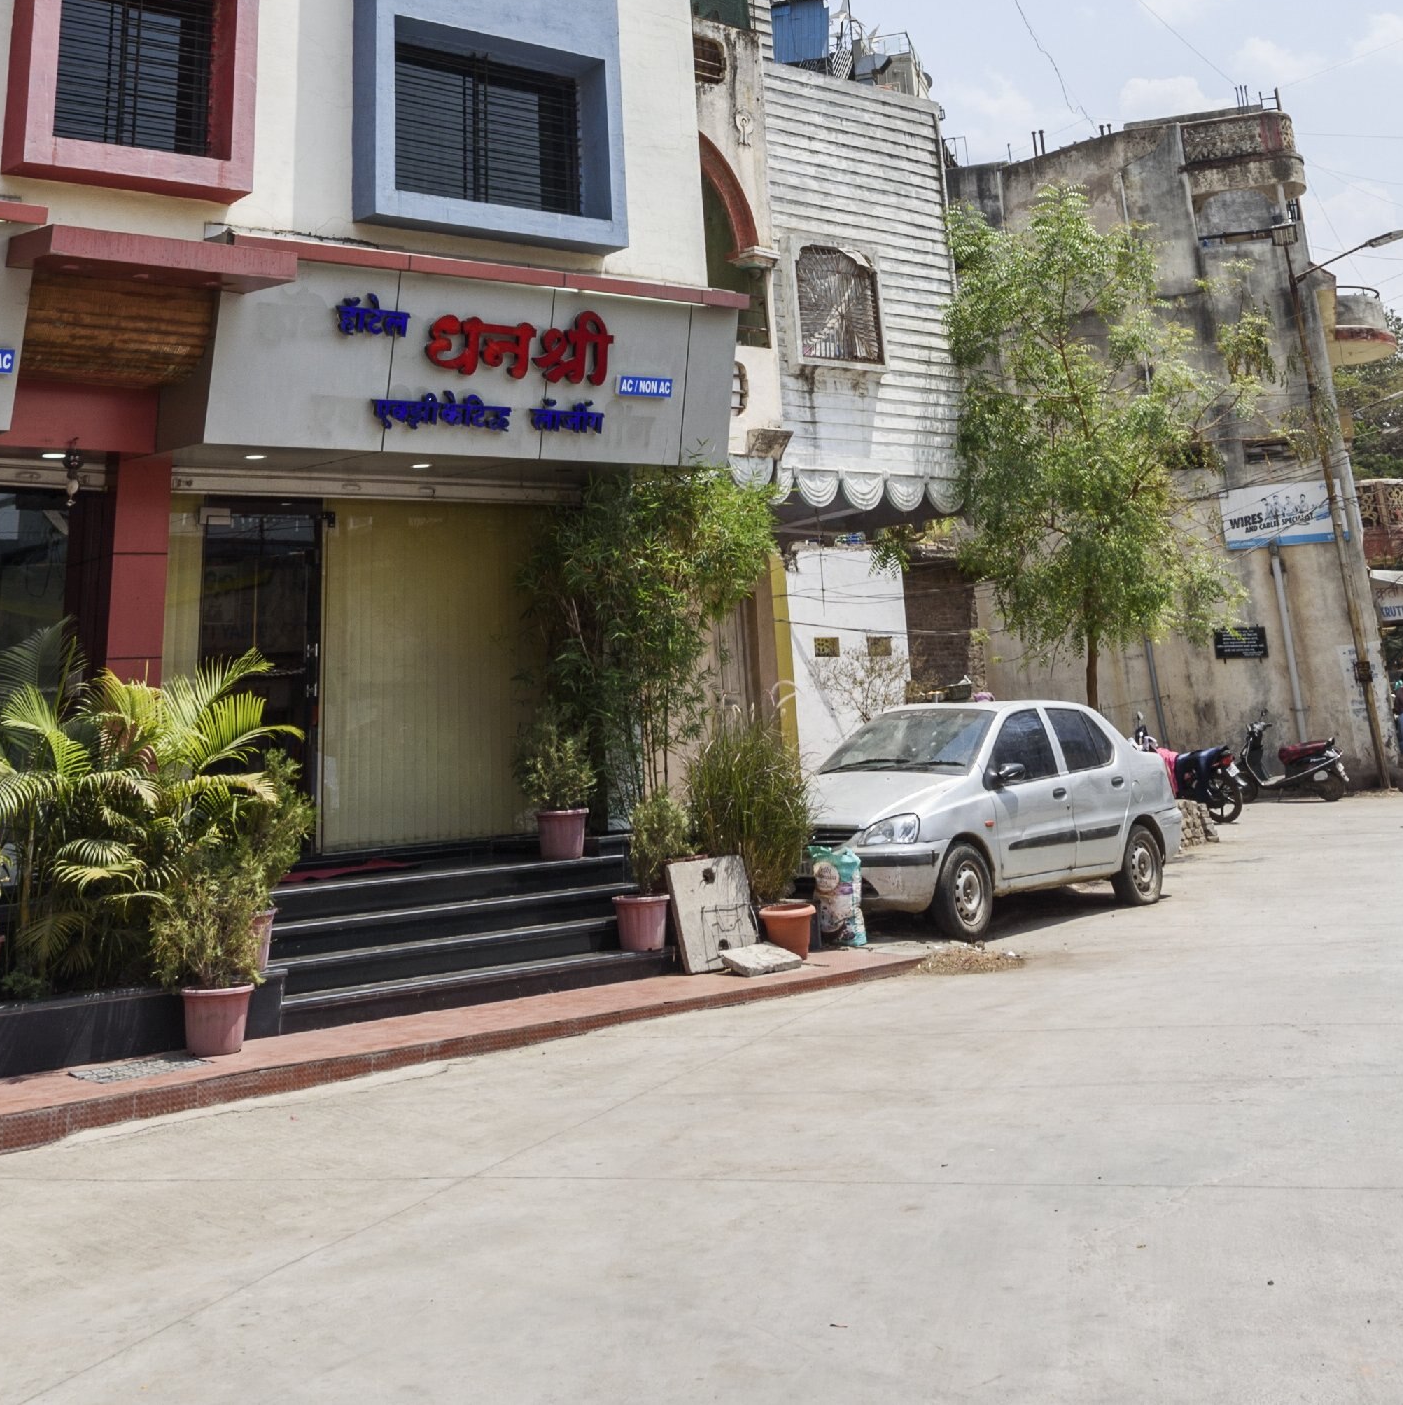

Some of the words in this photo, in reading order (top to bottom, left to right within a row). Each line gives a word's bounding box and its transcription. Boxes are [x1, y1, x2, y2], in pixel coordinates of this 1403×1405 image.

[621, 379, 633, 392] AC
[639, 380, 657, 394] NON
[659, 381, 671, 394] AC
[1230, 512, 1264, 530] WIRES
[1245, 524, 1258, 533] AND
